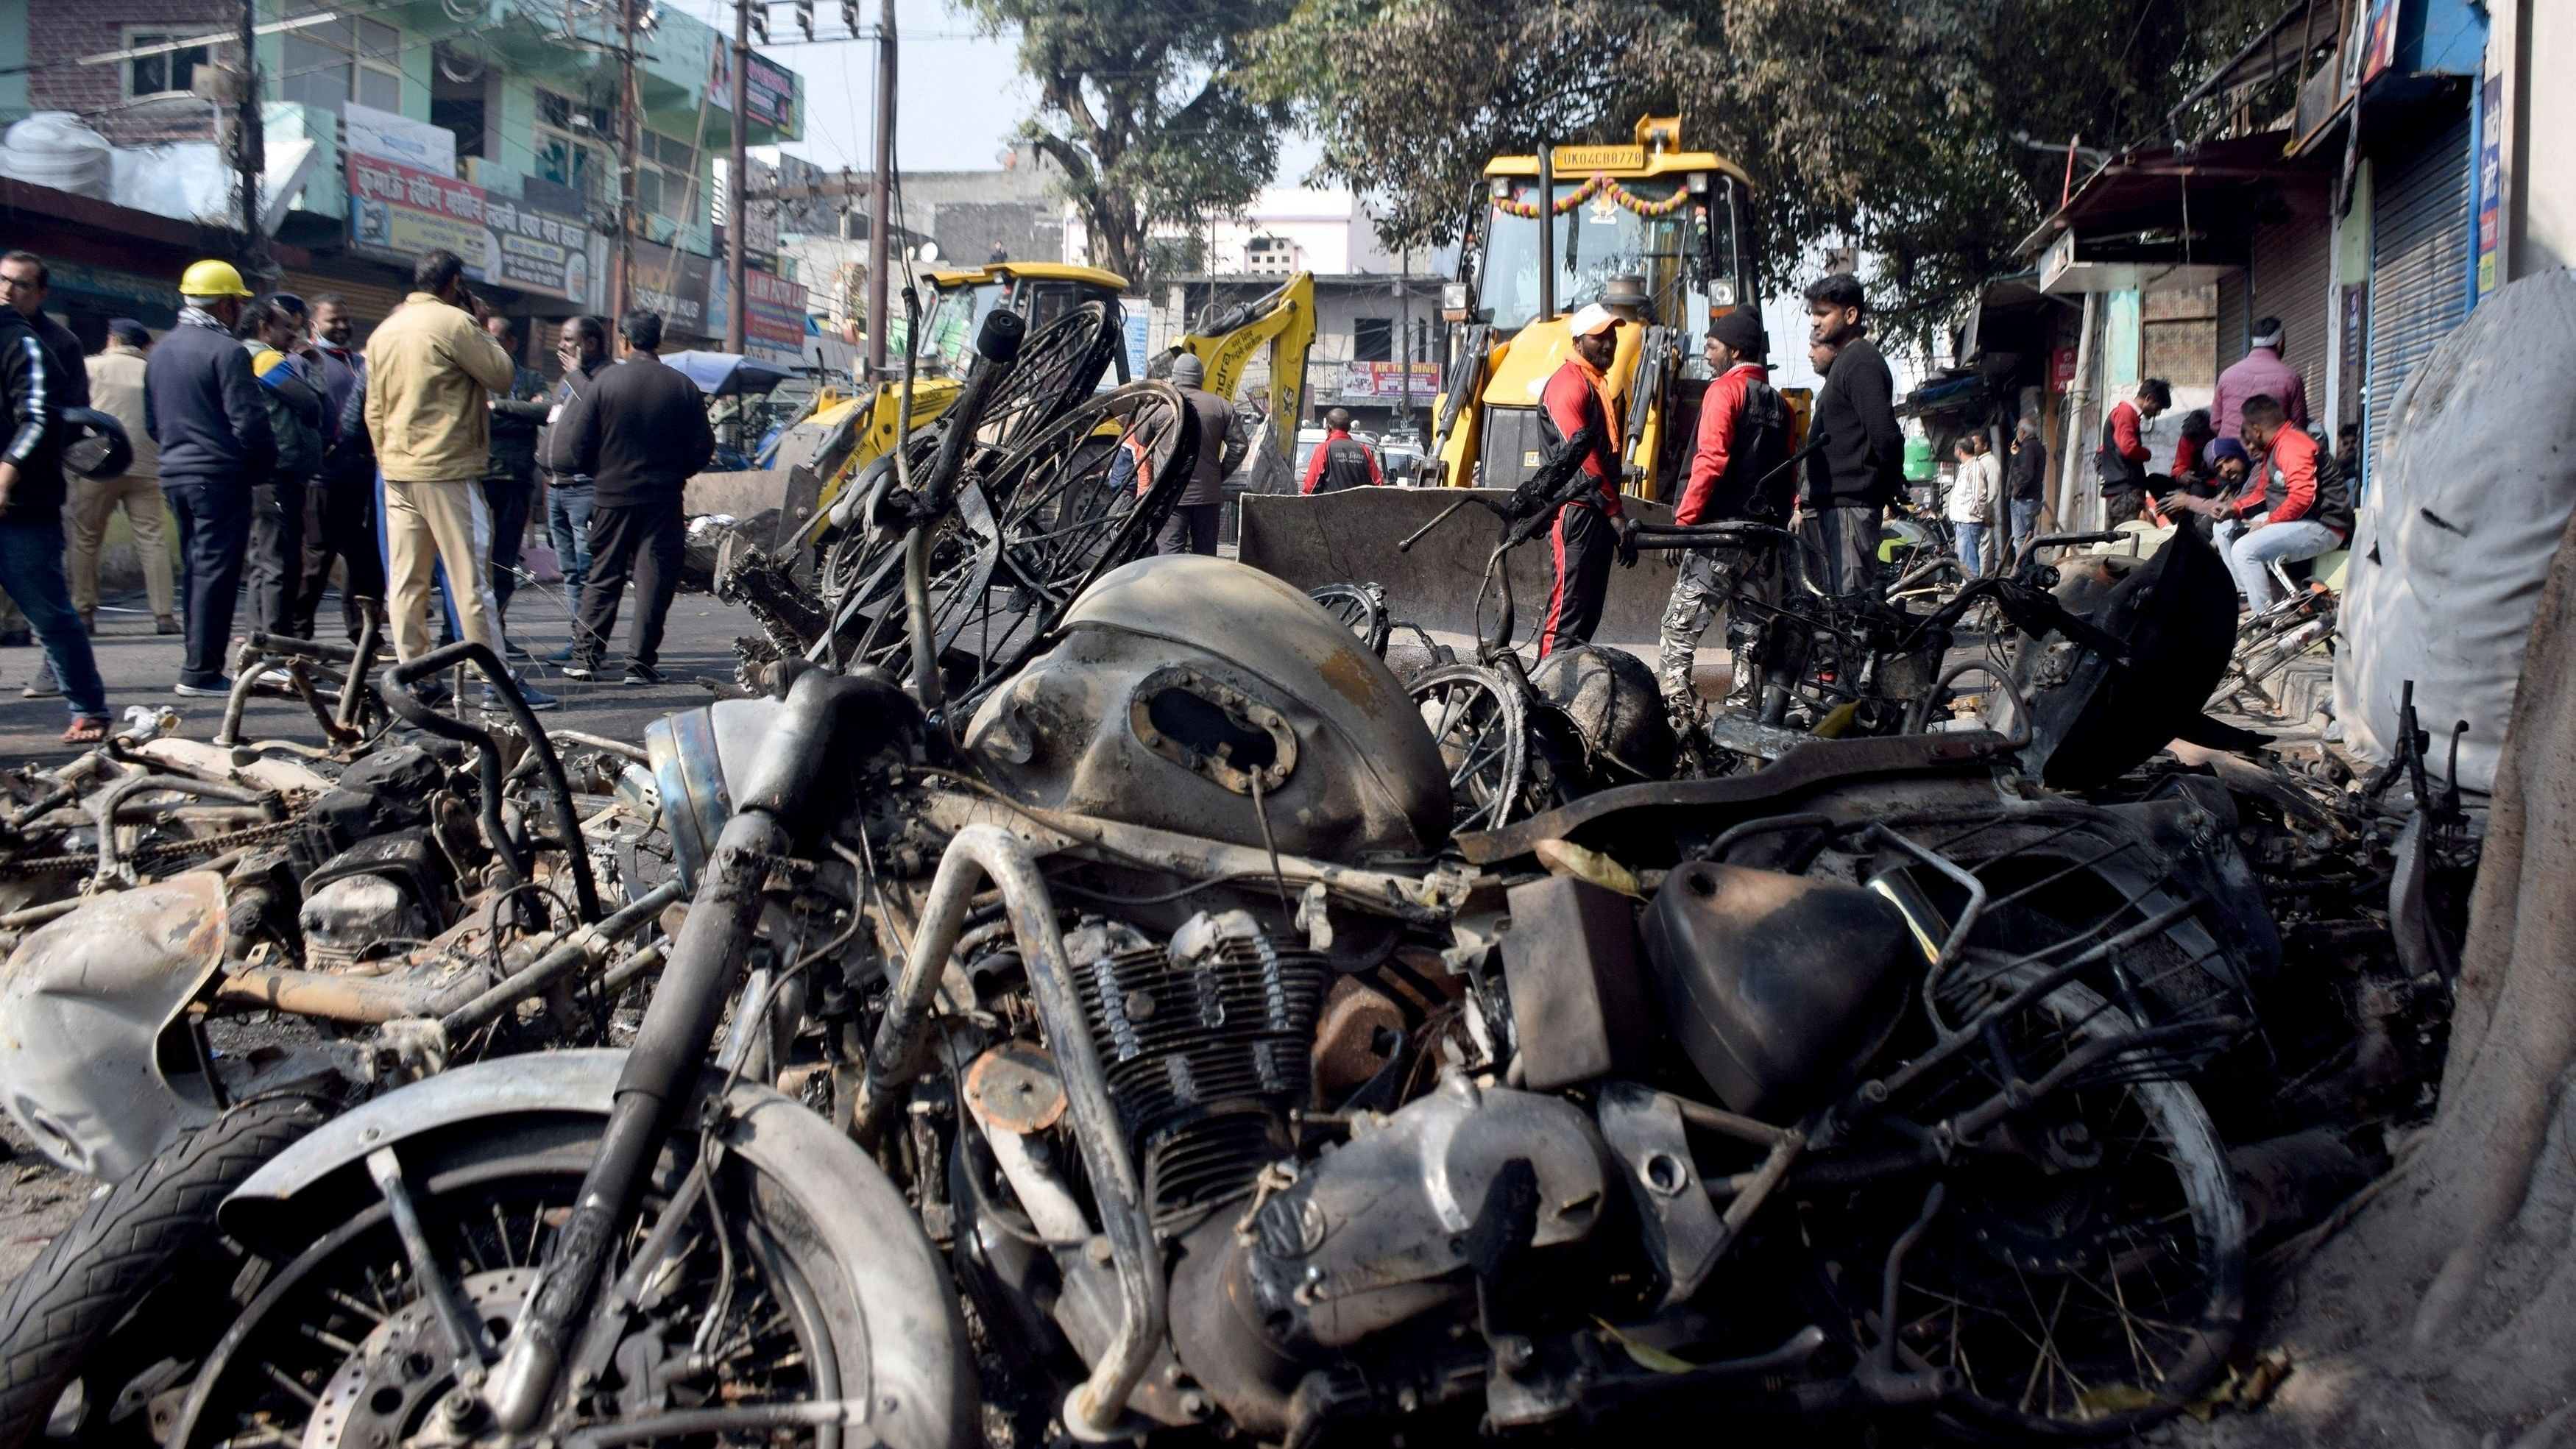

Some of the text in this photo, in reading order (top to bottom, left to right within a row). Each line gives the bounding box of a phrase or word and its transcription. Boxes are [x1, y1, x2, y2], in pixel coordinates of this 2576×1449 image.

[1563, 152, 1641, 166] UK04CB8778
[1376, 364, 1388, 373] AK
[1392, 364, 1437, 374] TRDING
